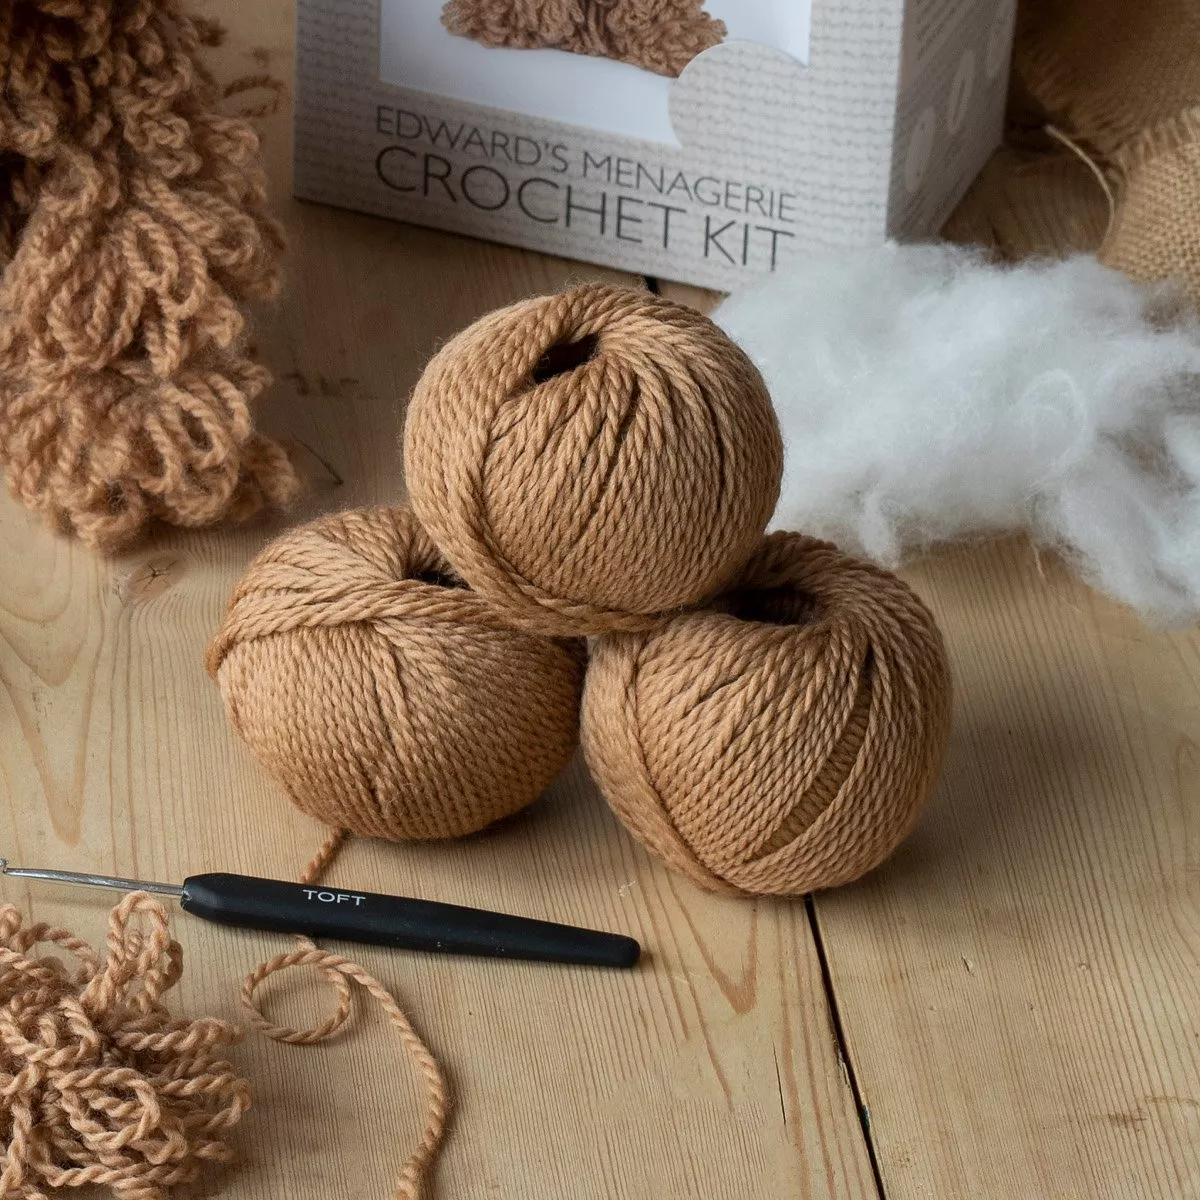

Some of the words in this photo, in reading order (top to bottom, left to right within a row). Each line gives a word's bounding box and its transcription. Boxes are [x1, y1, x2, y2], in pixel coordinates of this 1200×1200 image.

[375, 104, 570, 174] EDWARD'S
[581, 150, 797, 223] MENAGERIE
[375, 145, 688, 250] CROCHET
[703, 215, 796, 272] KIT
[302, 889, 367, 906] TOFT
